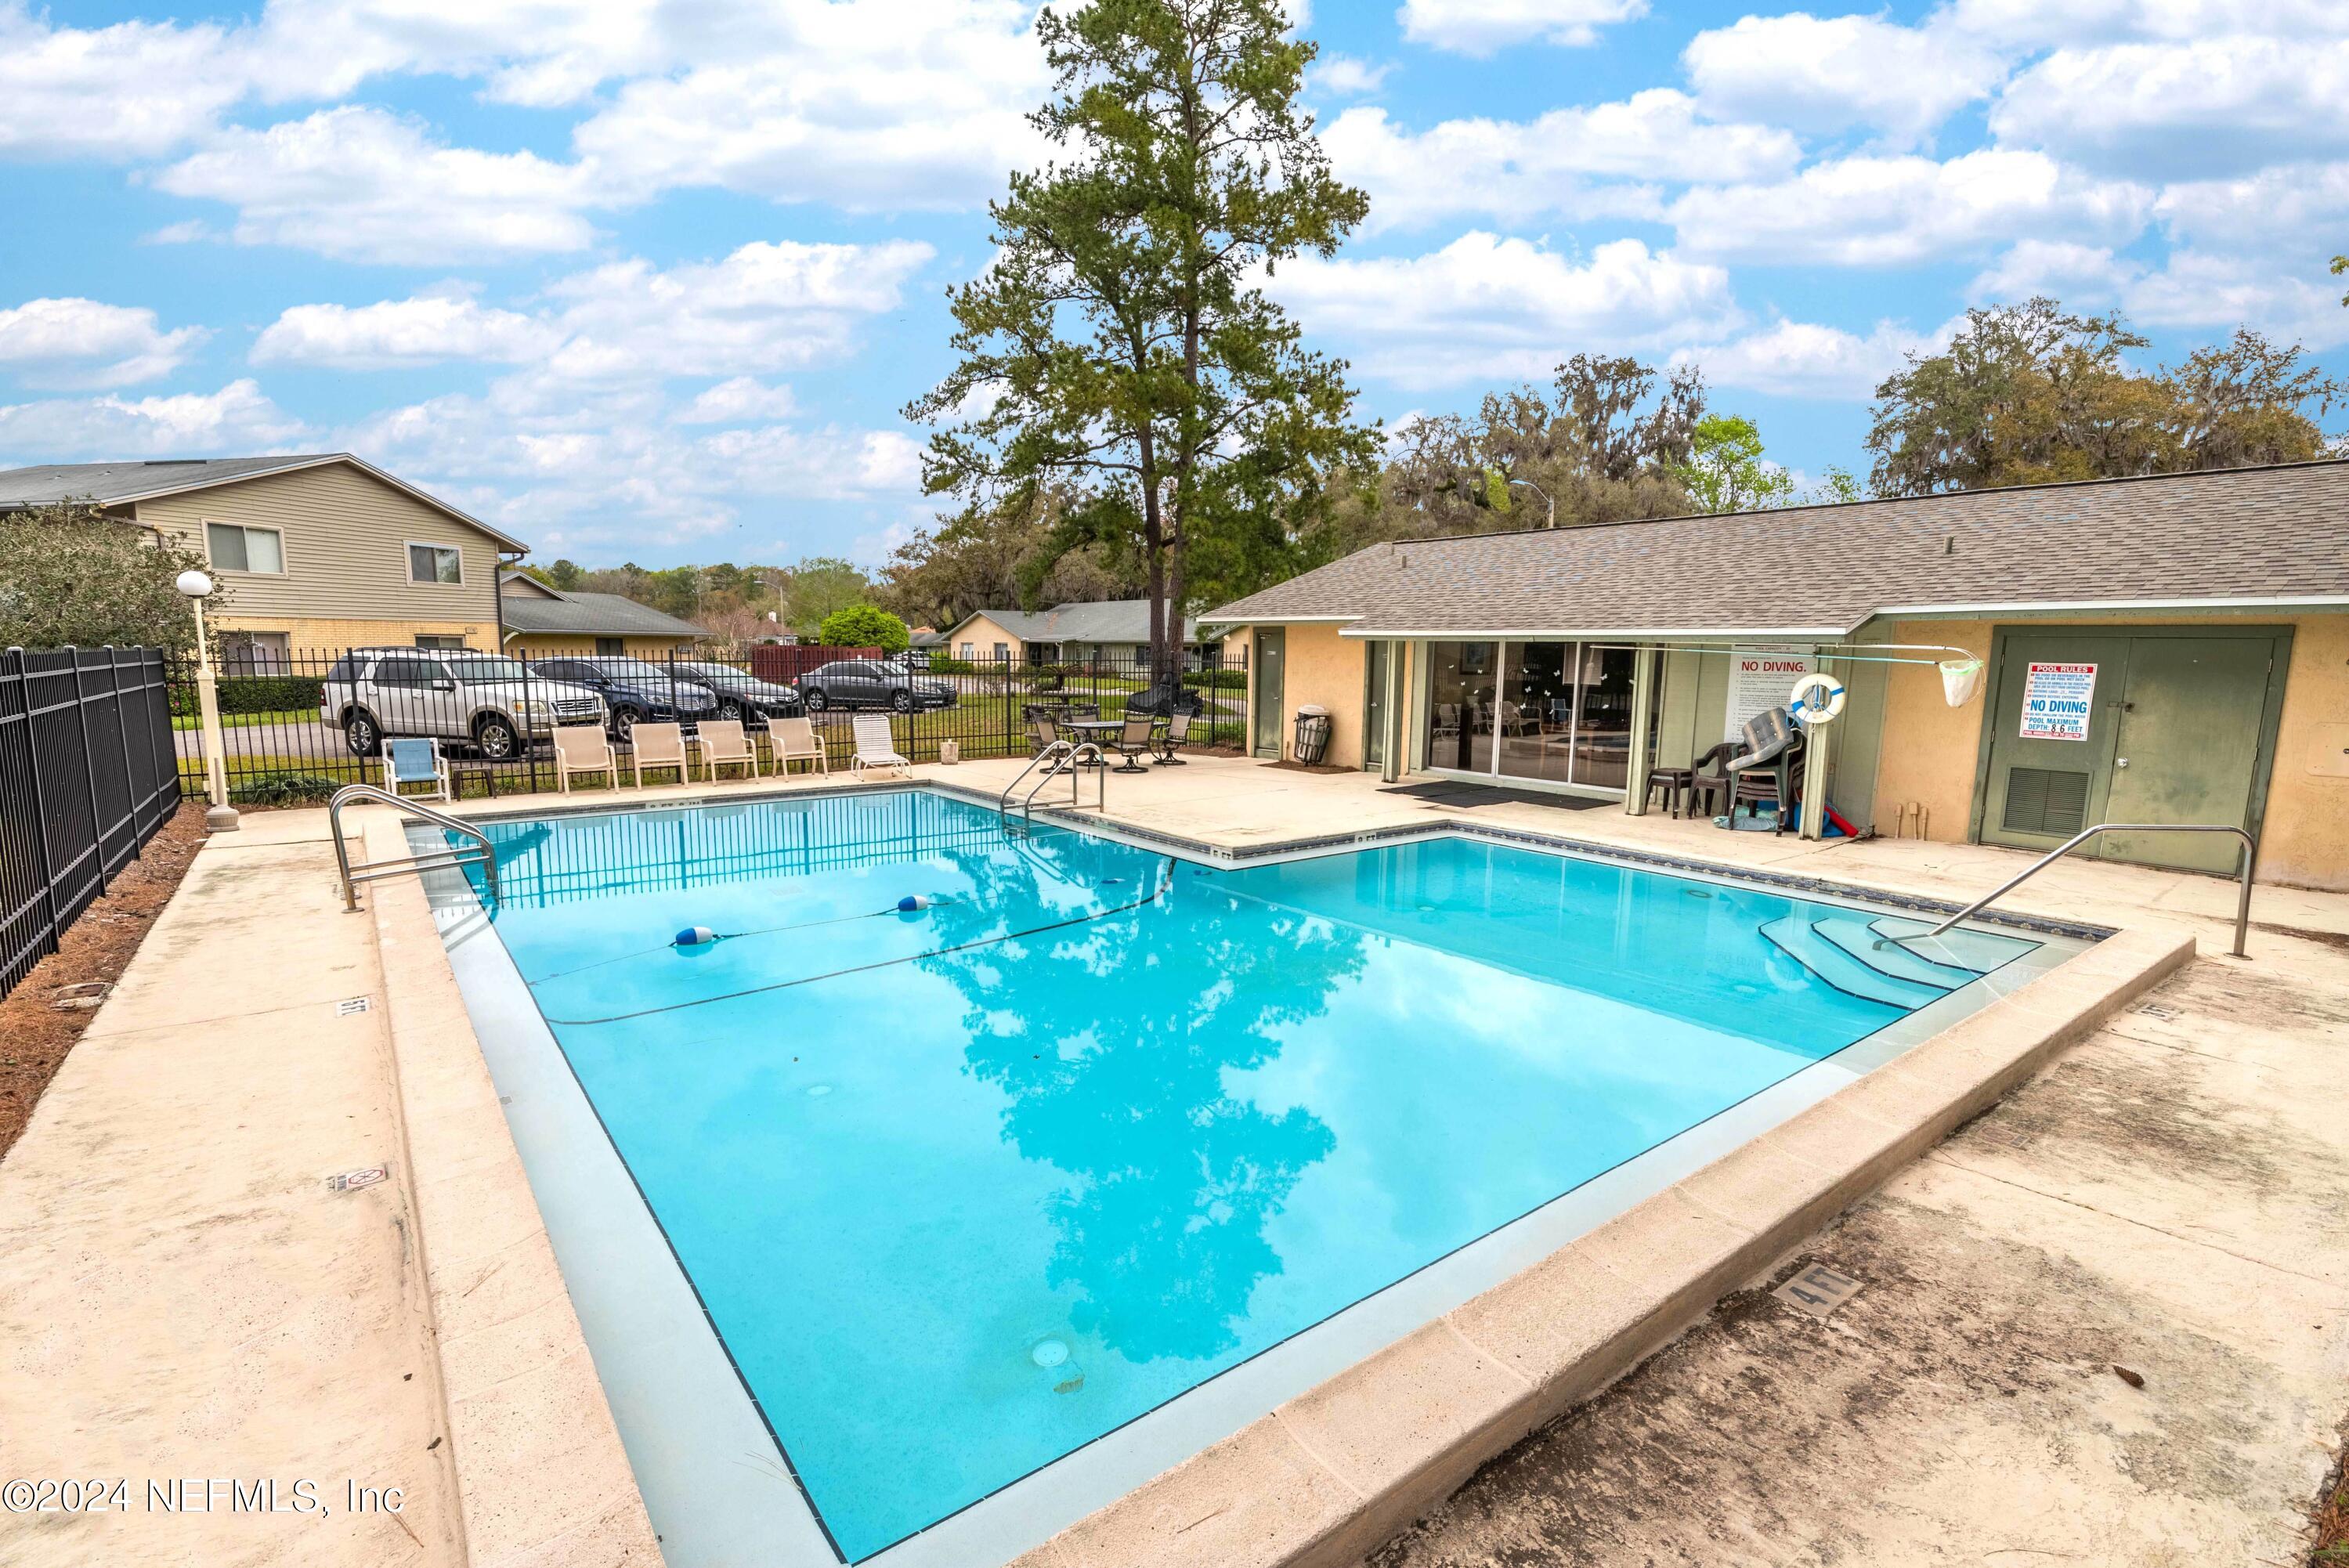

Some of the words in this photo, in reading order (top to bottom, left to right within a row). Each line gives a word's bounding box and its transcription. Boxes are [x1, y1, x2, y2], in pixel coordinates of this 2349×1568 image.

[1741, 661, 1758, 671] NO
[1763, 661, 1806, 672] DIVING.
[2030, 699, 2046, 711] NO
[2049, 700, 2087, 713] DIVING
[1788, 1286, 1829, 1305] 4
